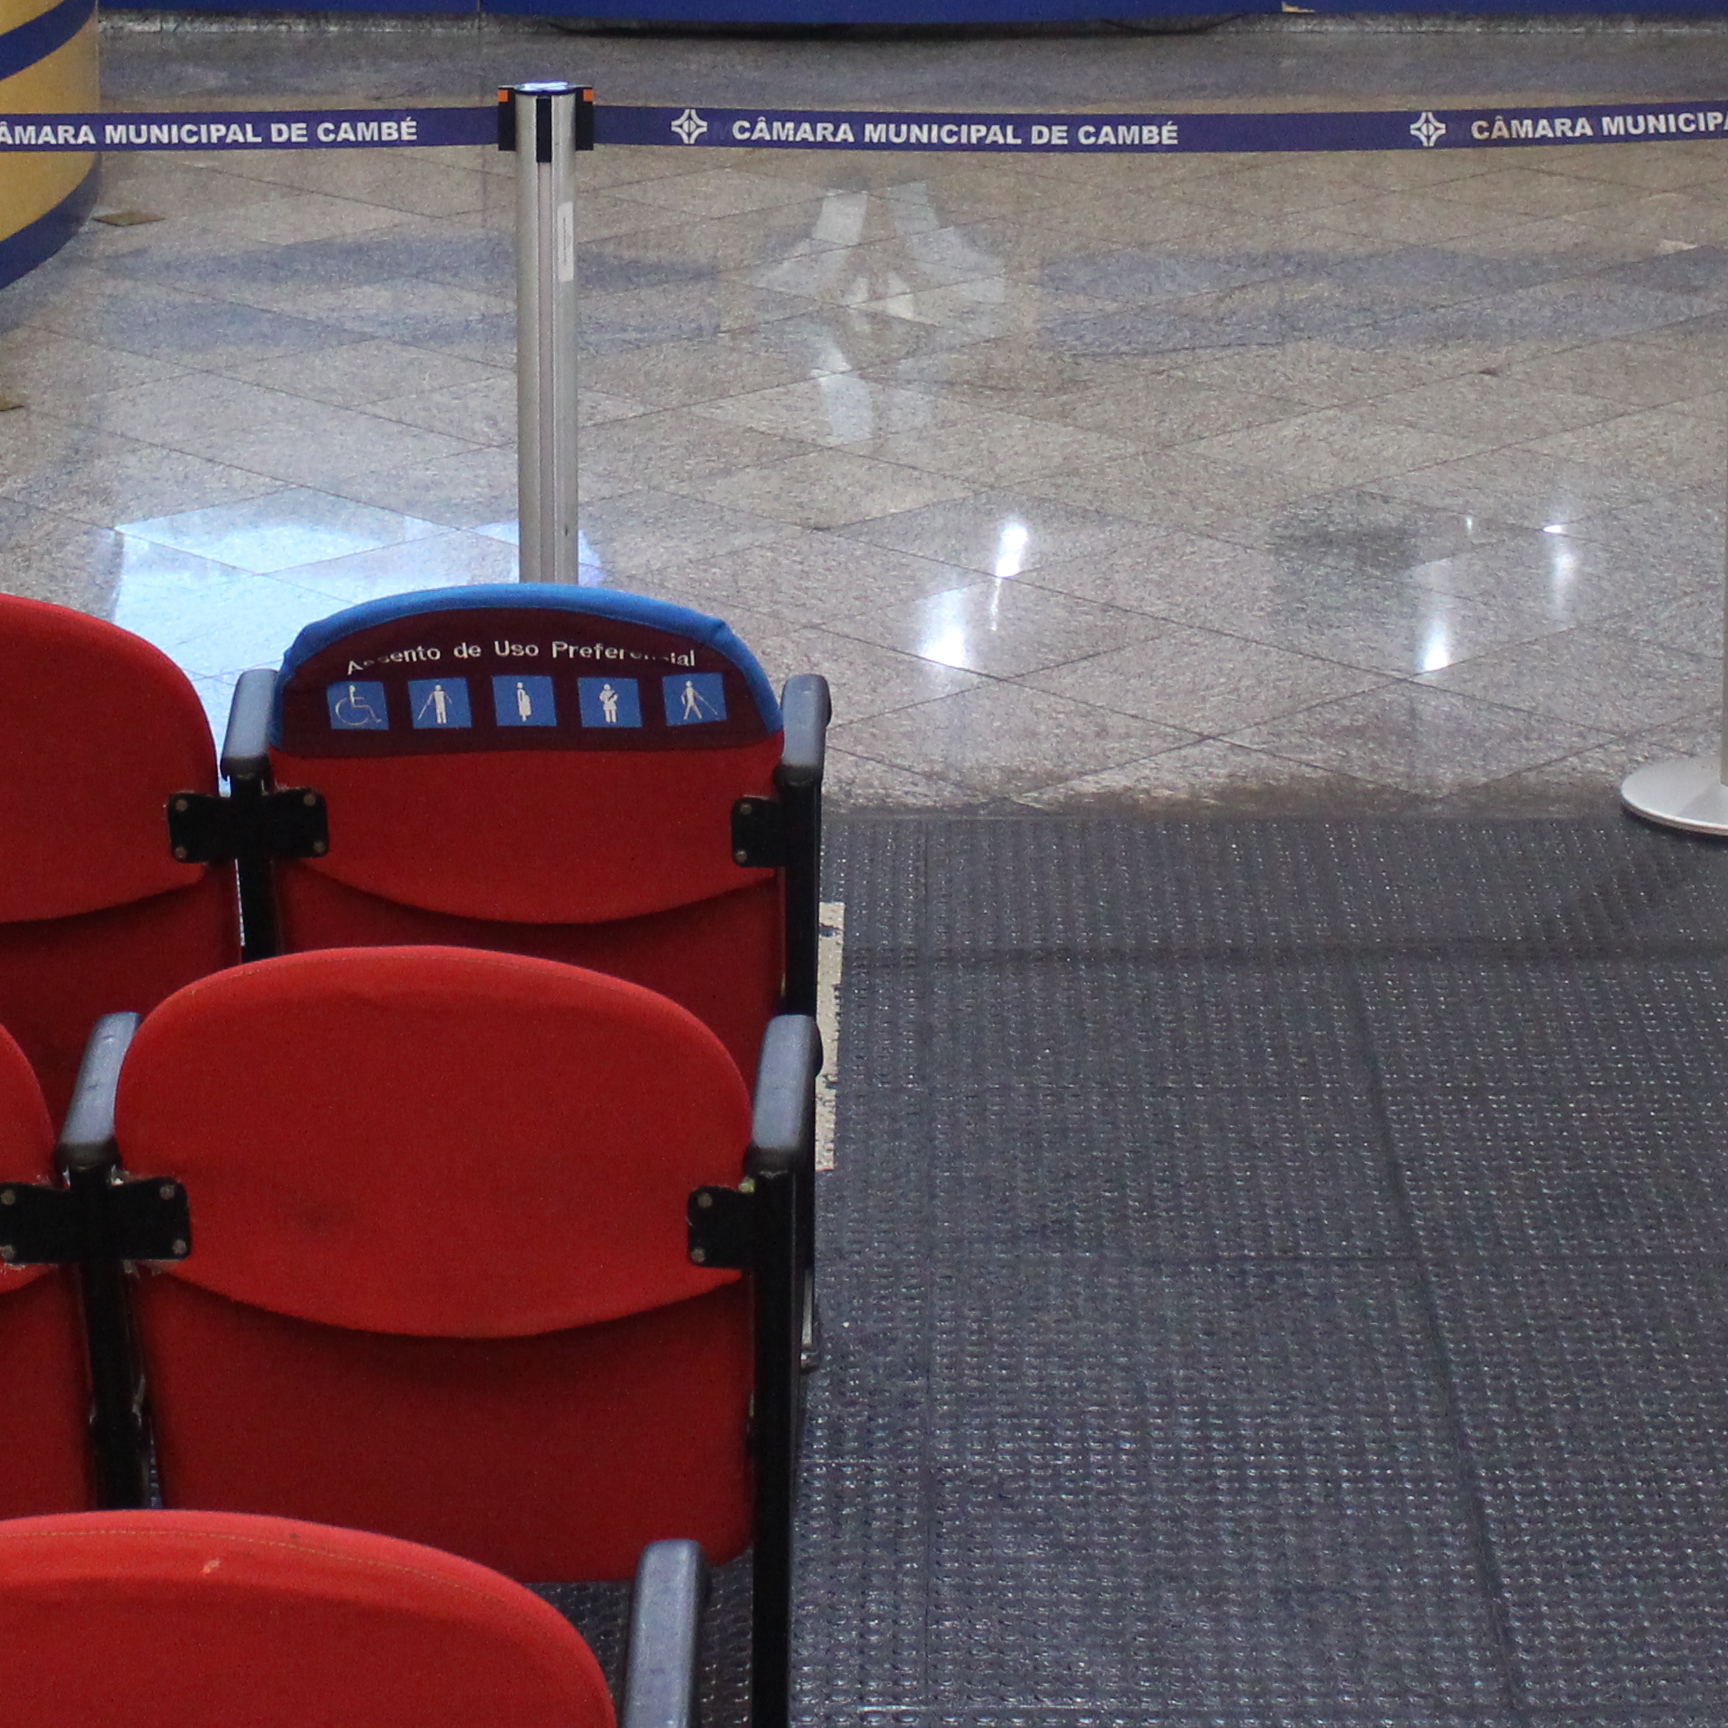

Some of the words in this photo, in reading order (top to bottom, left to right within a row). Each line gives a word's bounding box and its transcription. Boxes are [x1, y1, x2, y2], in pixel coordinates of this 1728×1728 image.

[103, 123, 263, 145] MUNICIPAL
[270, 122, 308, 144] DE
[316, 116, 418, 143] CAMBÉ
[730, 116, 855, 144] CÂMARA
[864, 121, 1023, 145] MUNICIPAL
[1032, 122, 1071, 144] DE
[1077, 115, 1179, 145] CAMBÉ
[1470, 112, 1593, 141] CÂMARA
[453, 643, 482, 658] de
[494, 640, 540, 657] Uso
[551, 640, 696, 667] Preferial
